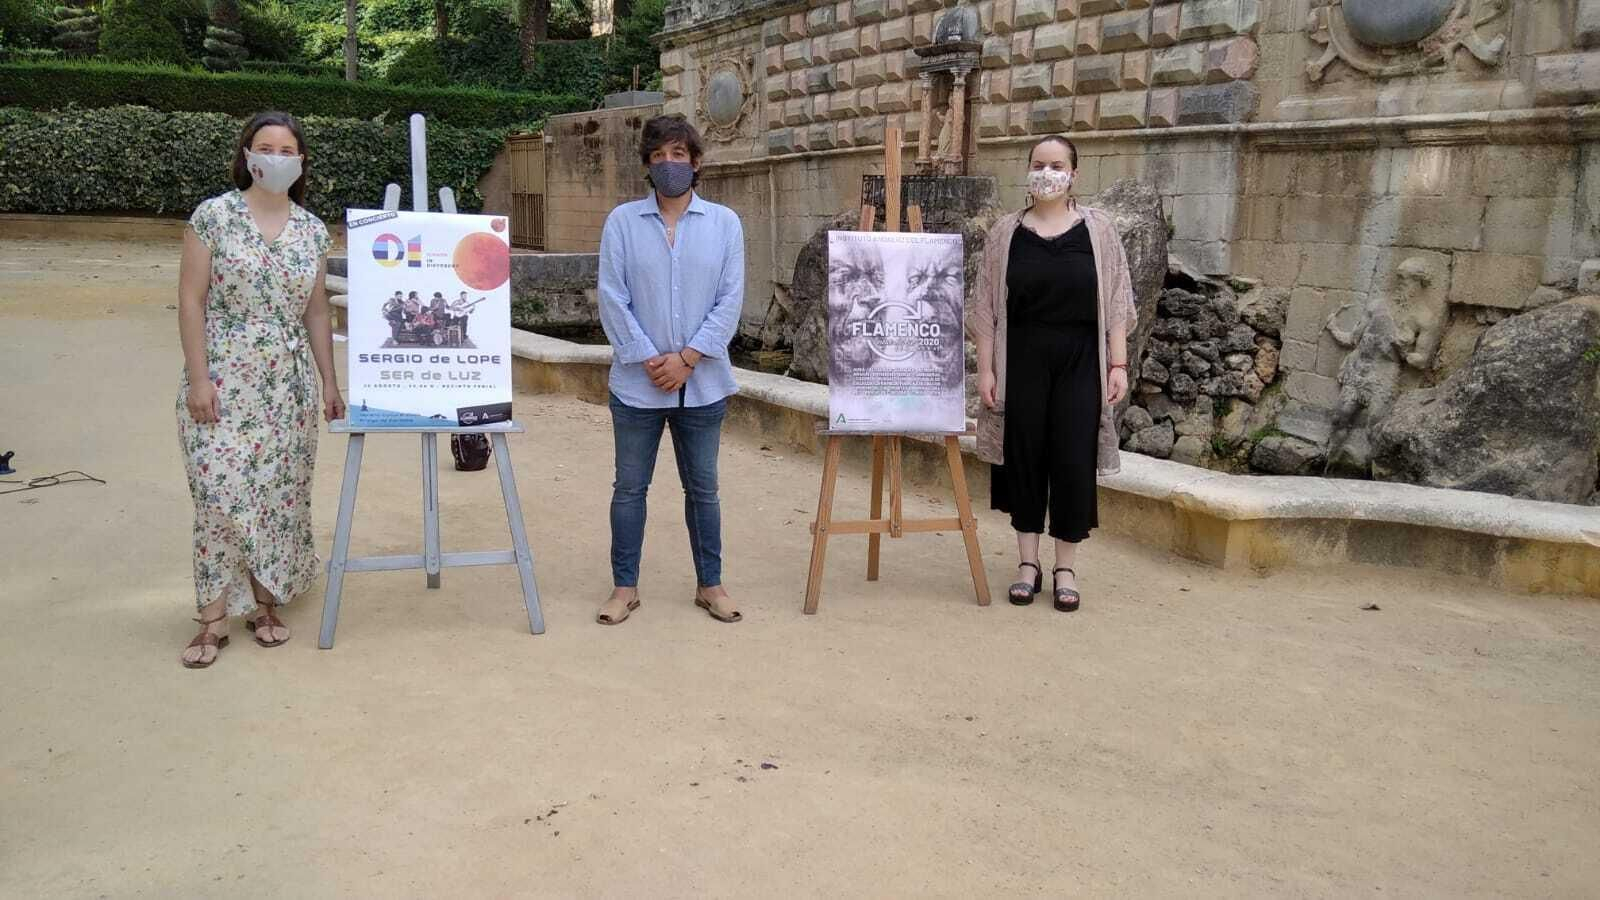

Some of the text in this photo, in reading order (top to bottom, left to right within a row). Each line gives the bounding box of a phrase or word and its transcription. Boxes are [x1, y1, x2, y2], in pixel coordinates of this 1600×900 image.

[852, 322, 941, 338] FLAMENCO
[919, 338, 940, 346] 2020
[358, 353, 501, 364] SERGIO de LOPE
[380, 370, 481, 381] SER de LUZ
